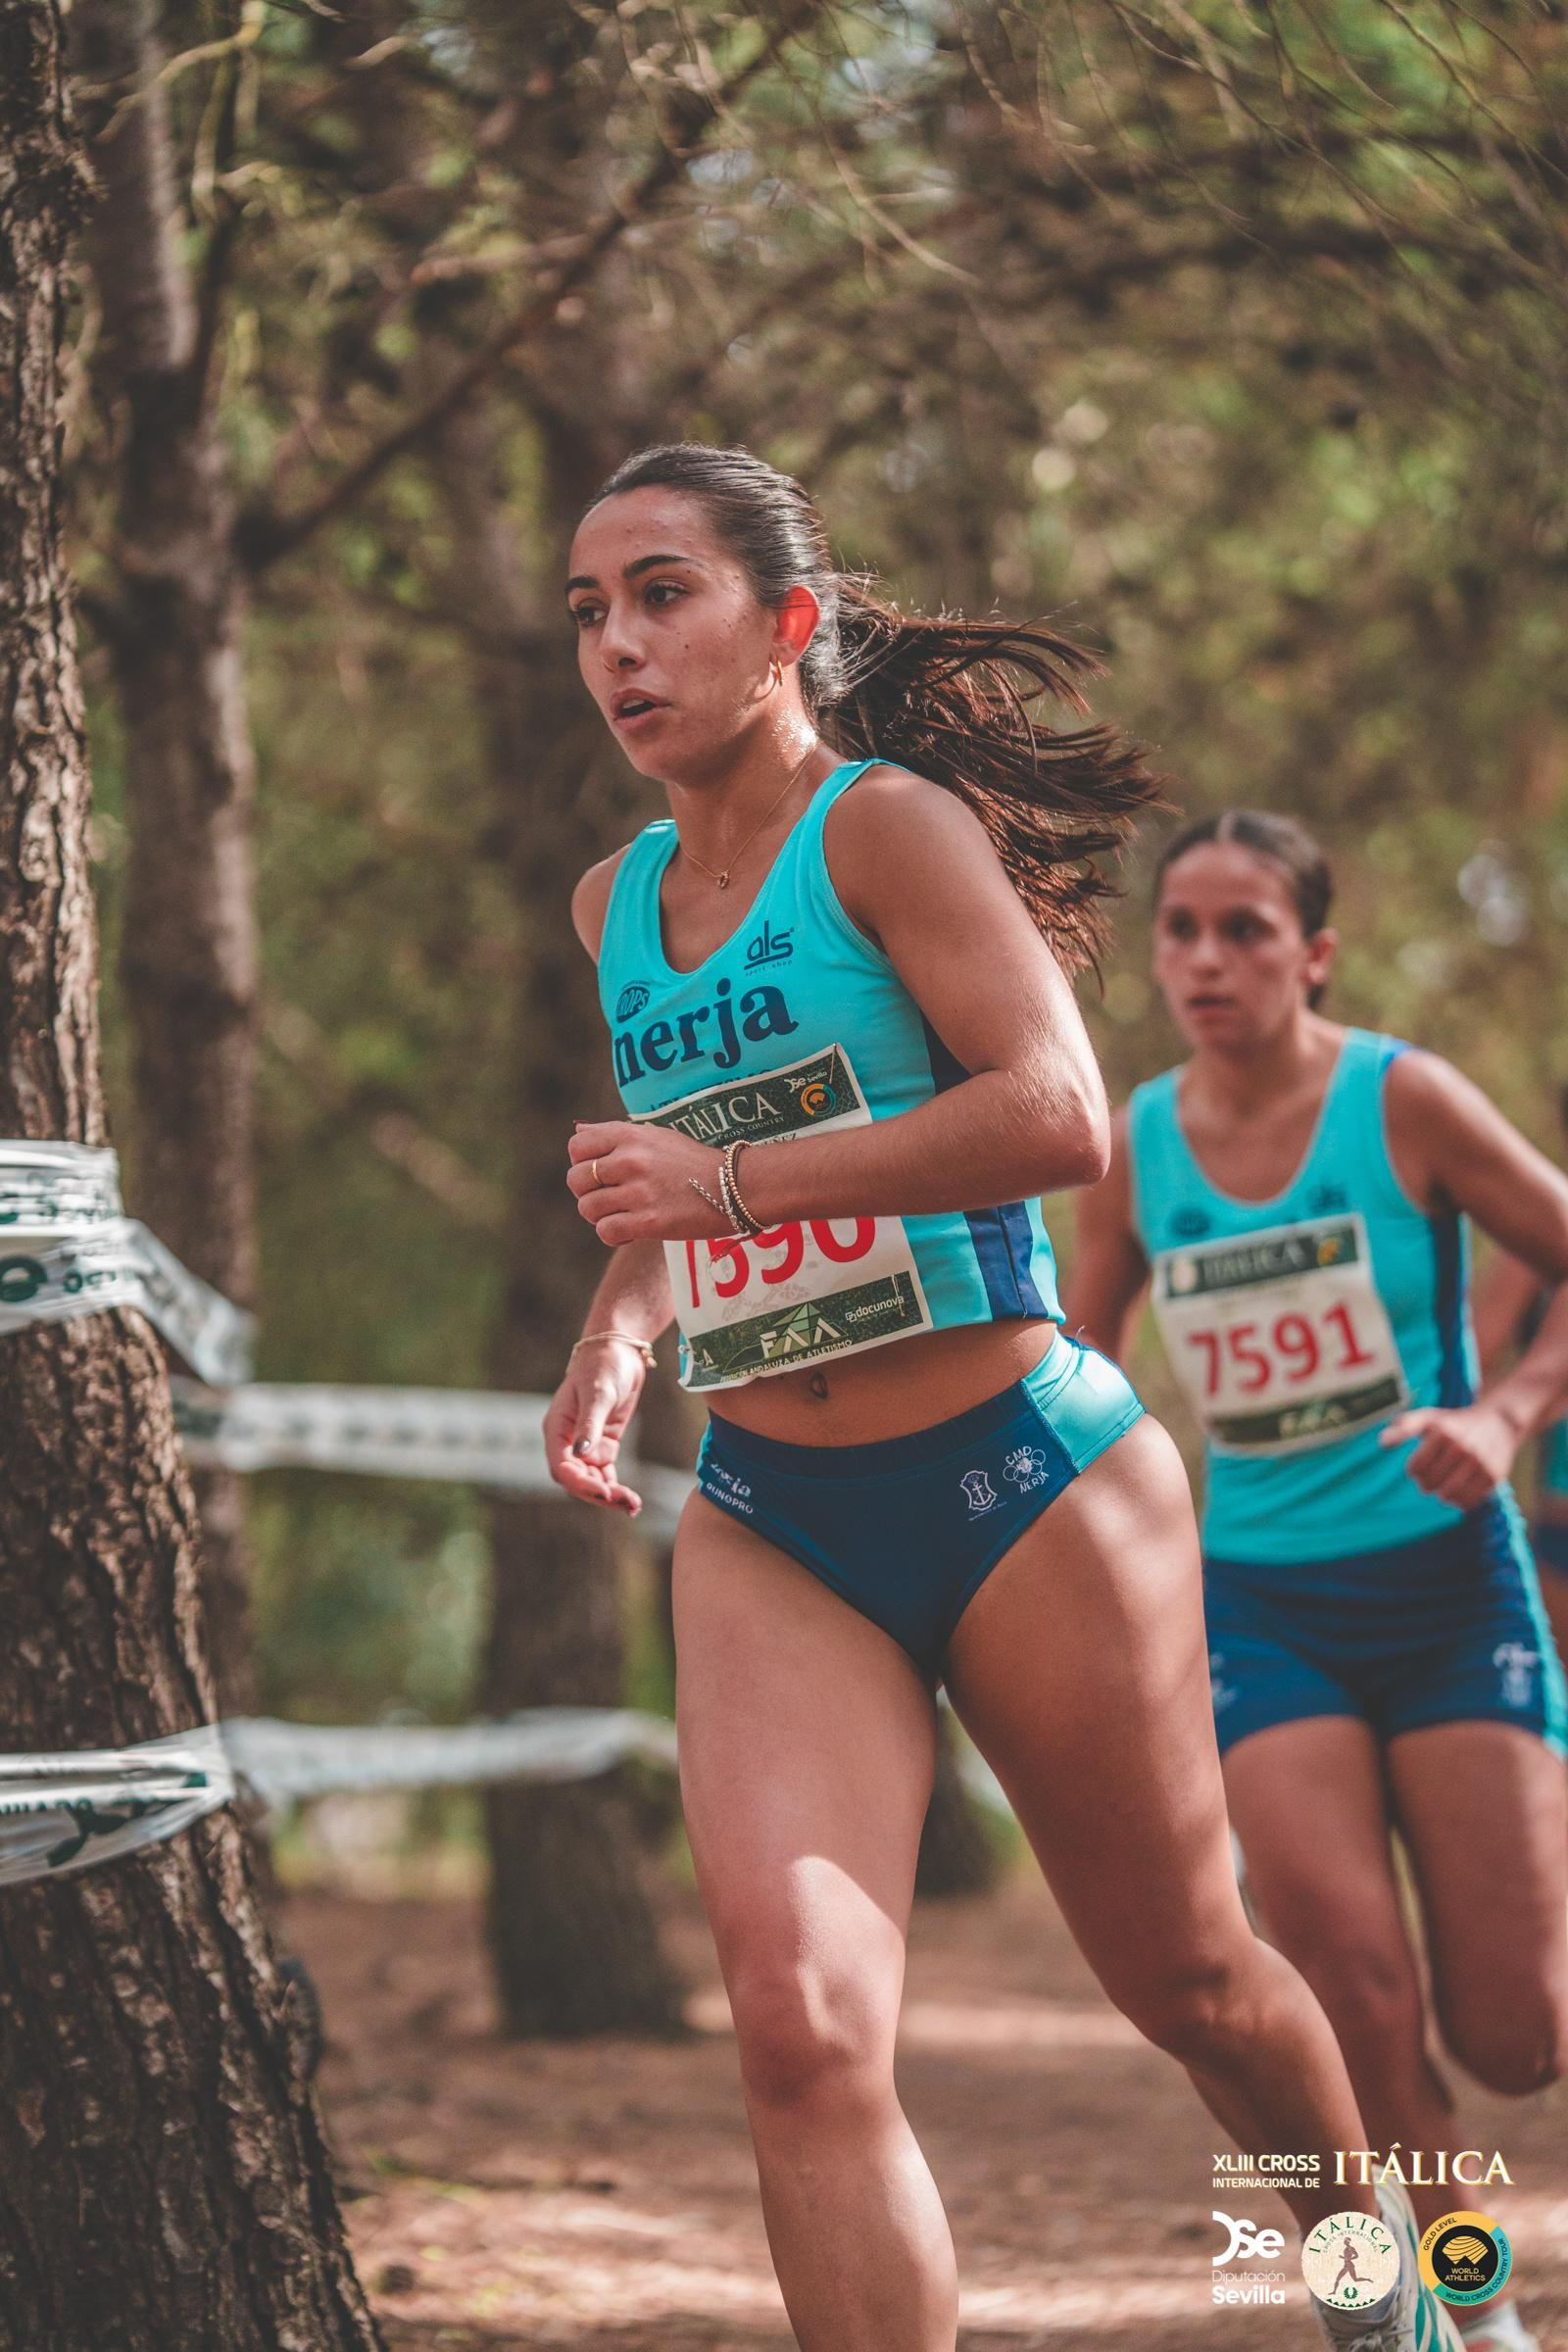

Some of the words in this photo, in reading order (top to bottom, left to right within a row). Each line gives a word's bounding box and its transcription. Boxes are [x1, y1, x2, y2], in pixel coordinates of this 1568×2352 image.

[613, 978, 800, 1089] nerja
[747, 1115, 785, 1131] COUNTRY
[855, 1295, 906, 1318] docunova
[750, 1357, 791, 1374] ANDALUZA
[793, 1353, 805, 1363] DE
[807, 1339, 853, 1359] ATLETISMO
[1188, 1299, 1375, 1398] 7591
[1004, 1446, 1032, 1465] CMD
[1019, 1470, 1050, 1494] NERJA
